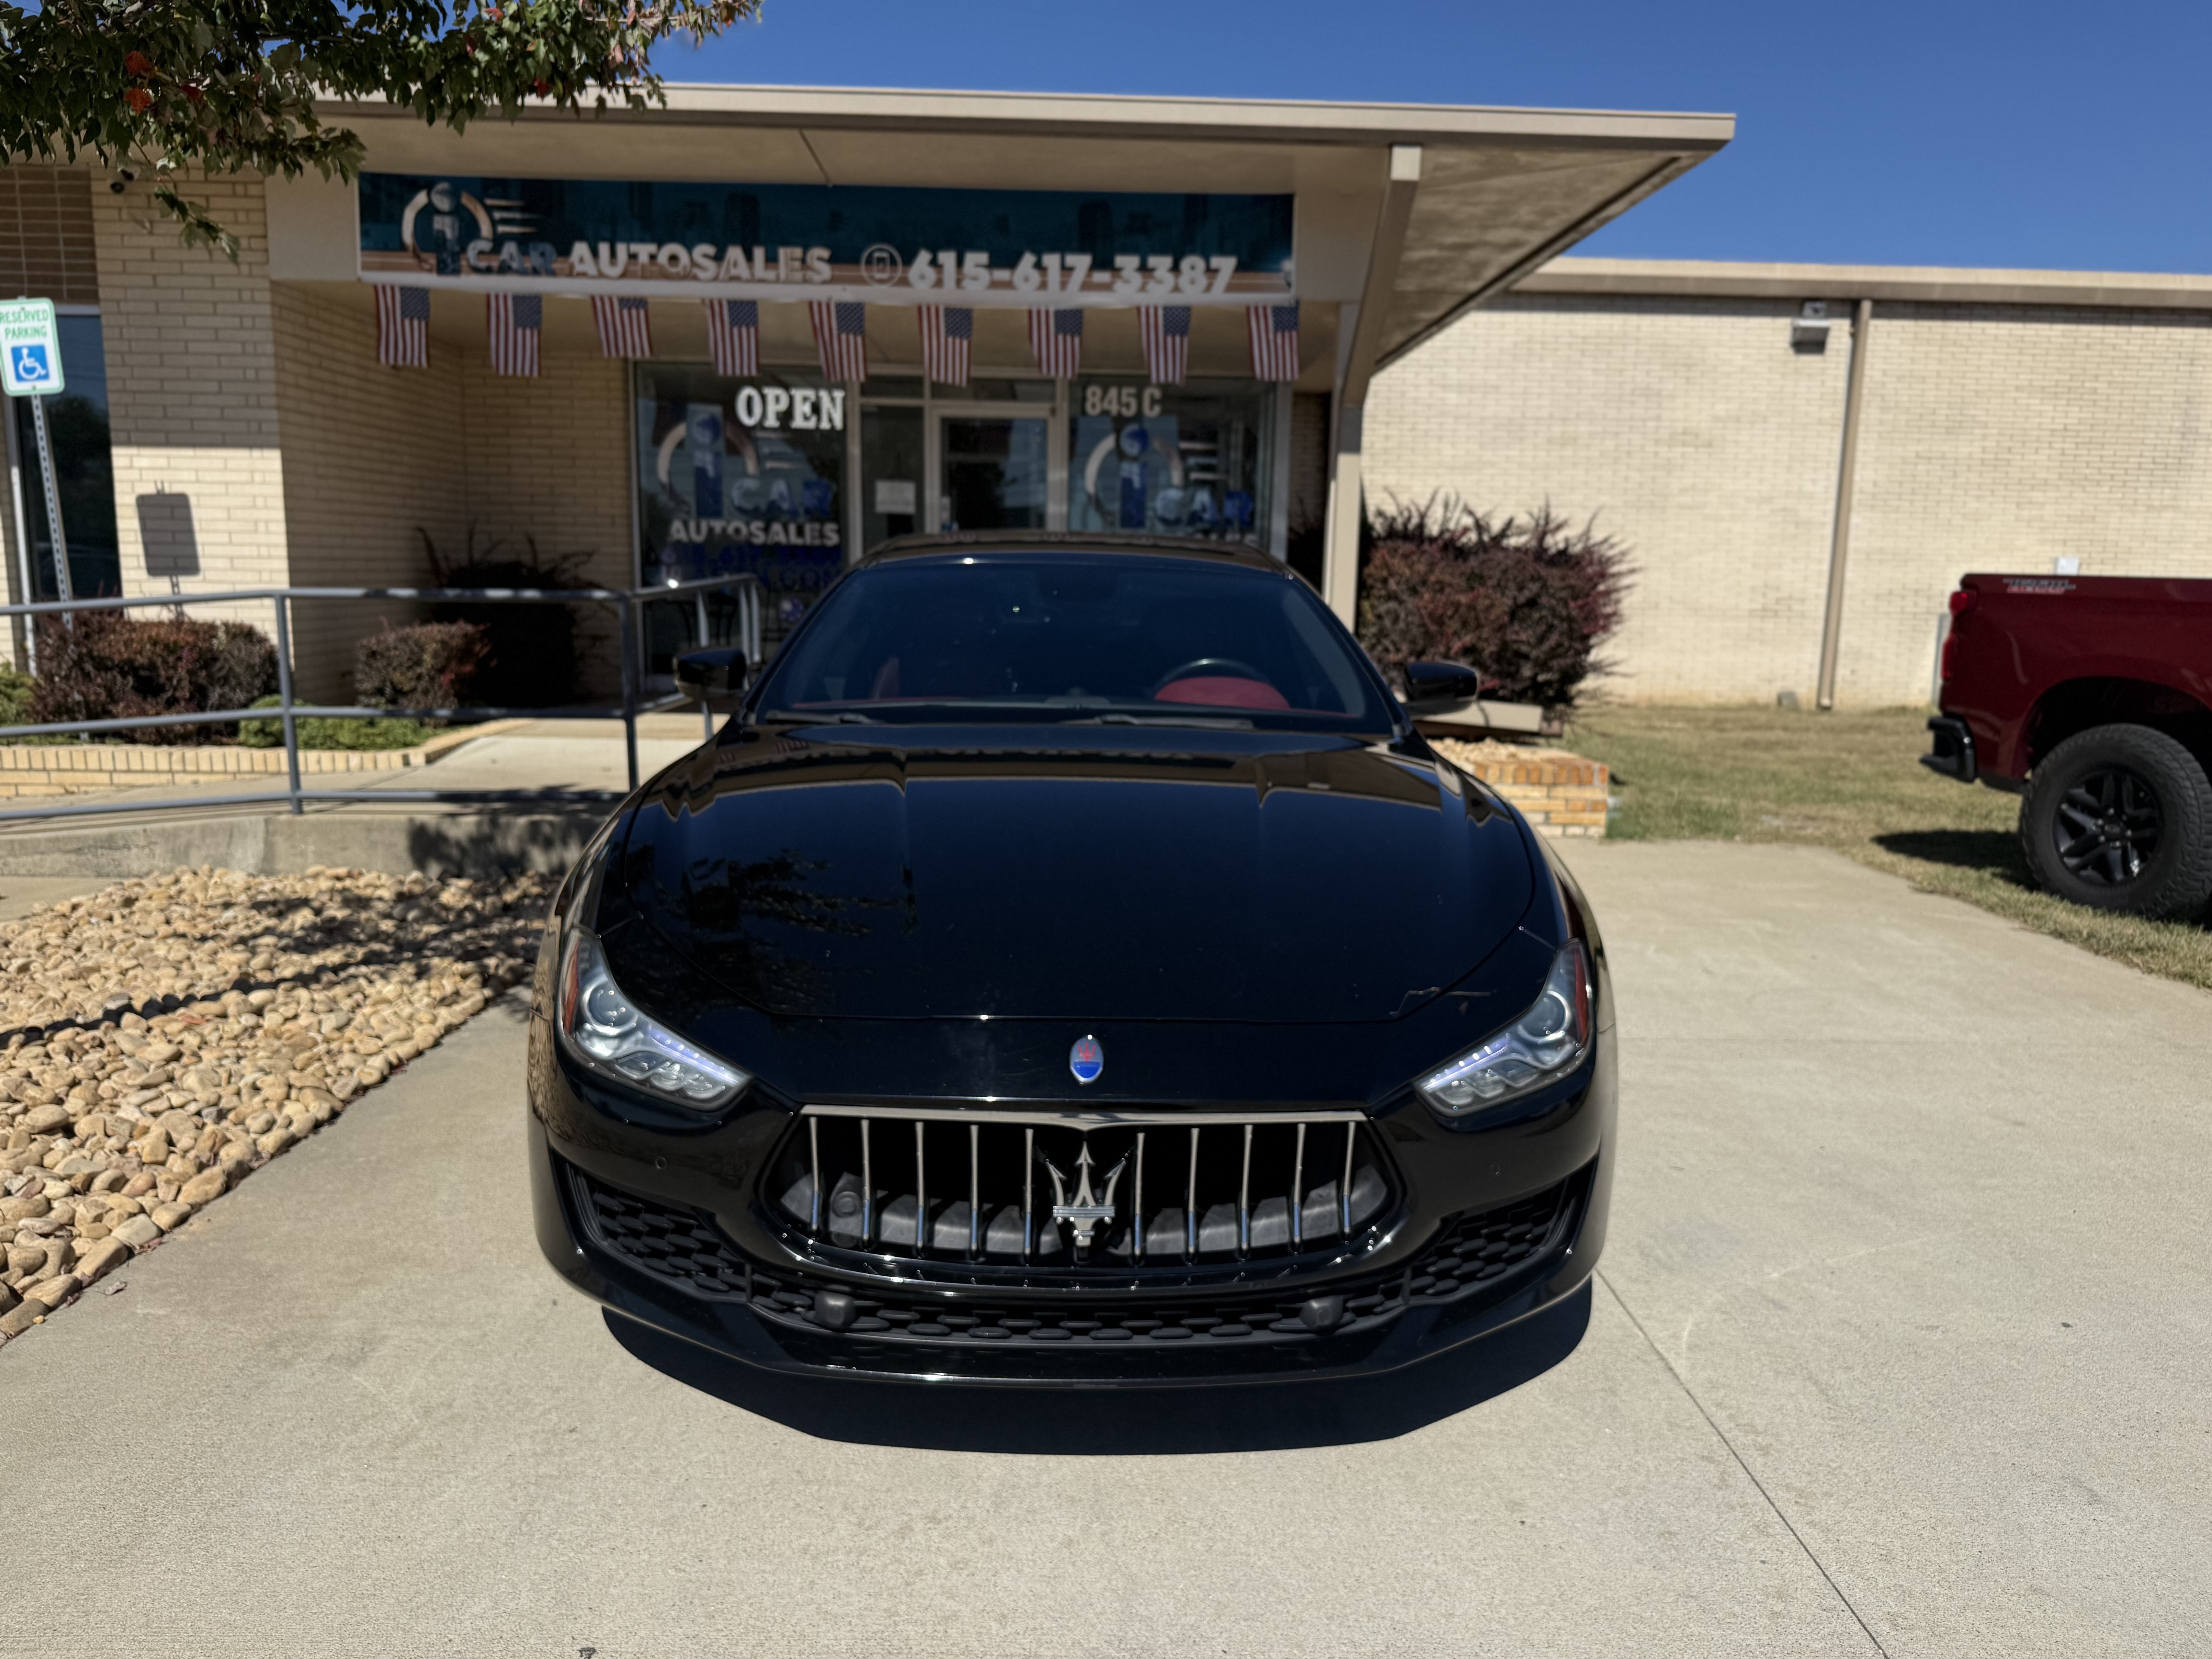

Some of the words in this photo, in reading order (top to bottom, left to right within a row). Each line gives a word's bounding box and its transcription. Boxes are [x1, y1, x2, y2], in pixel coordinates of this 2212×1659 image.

[569, 240, 833, 283] AUTOSALES
[907, 248, 1238, 295] 615-617-3387
[0, 309, 49, 324] RESERVED
[5, 325, 47, 340] PARKING
[736, 385, 845, 431] OPEN
[1085, 385, 1138, 418] 845
[1142, 386, 1162, 419] C
[670, 519, 840, 547] AUTOSALES
